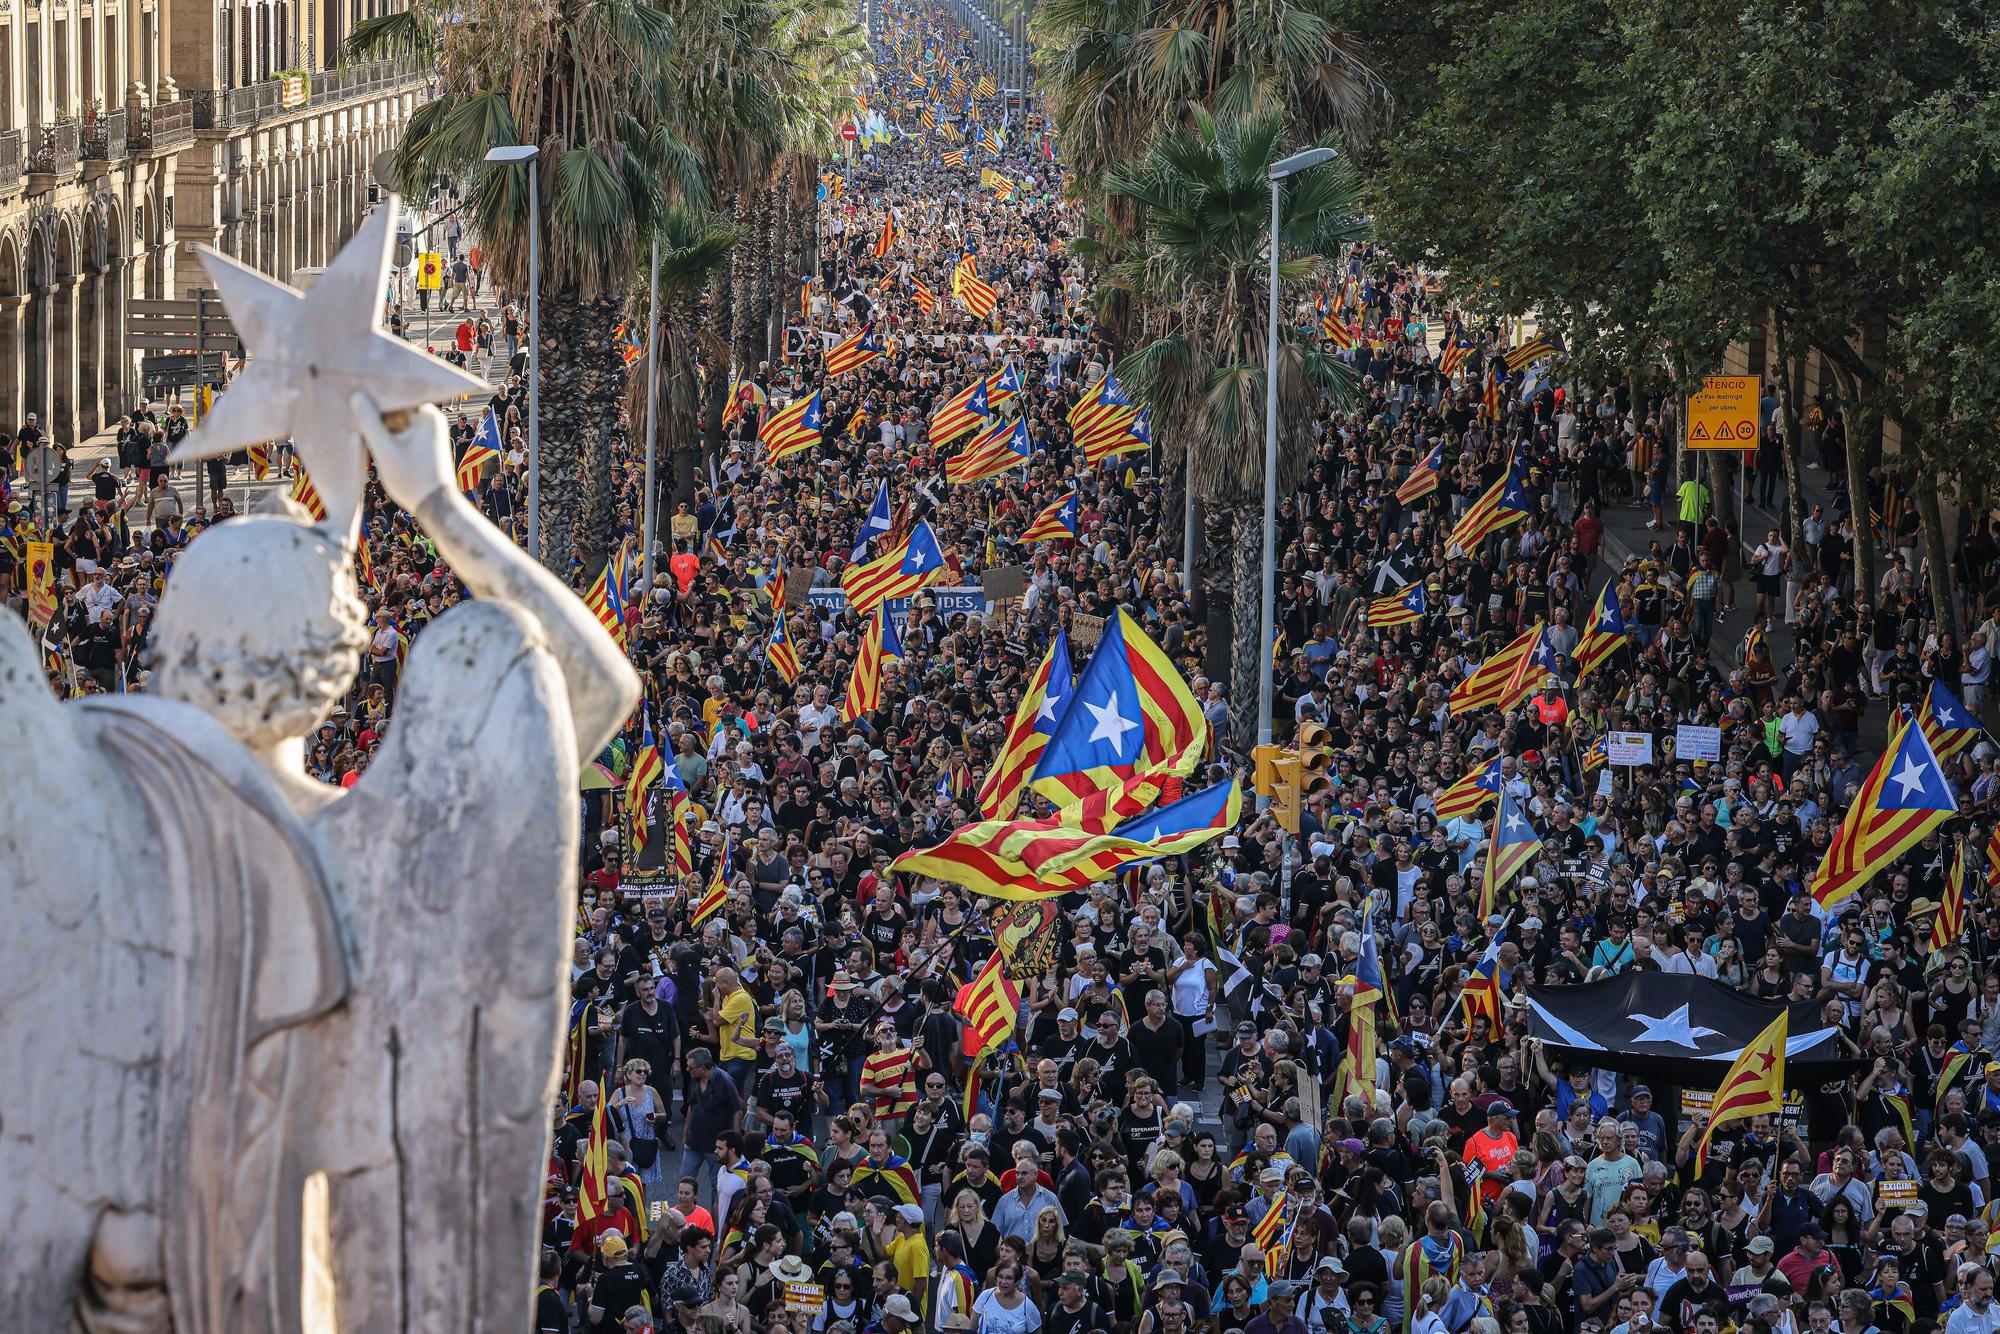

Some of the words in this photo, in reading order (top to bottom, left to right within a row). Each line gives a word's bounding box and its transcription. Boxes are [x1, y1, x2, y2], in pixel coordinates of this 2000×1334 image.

[1686, 1092, 1713, 1102] EXIGIM
[1883, 1182, 1912, 1191] EXIGIM
[790, 1284, 819, 1295] EXIGIM
